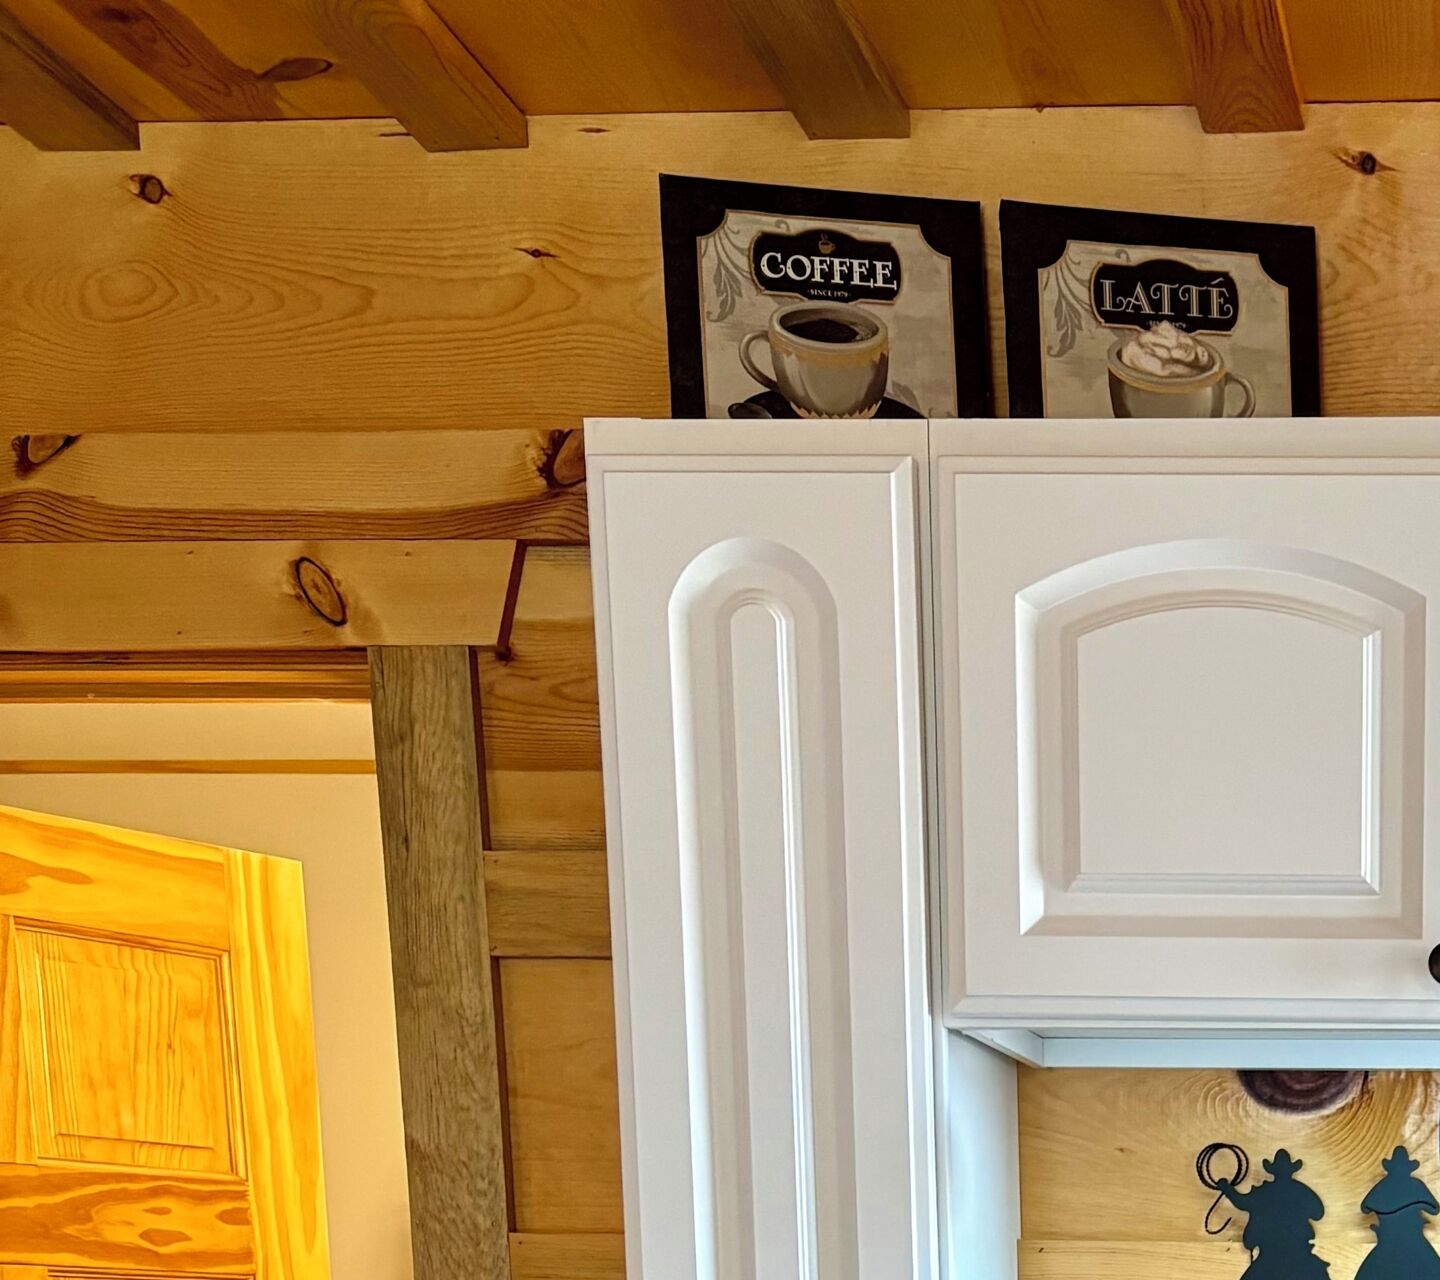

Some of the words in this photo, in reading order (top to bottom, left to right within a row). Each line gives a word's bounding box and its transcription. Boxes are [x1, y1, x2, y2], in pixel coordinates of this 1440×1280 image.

[760, 252, 897, 290] COFFEE
[810, 289, 832, 297] SINCE
[1100, 277, 1233, 319] LATTÉ
